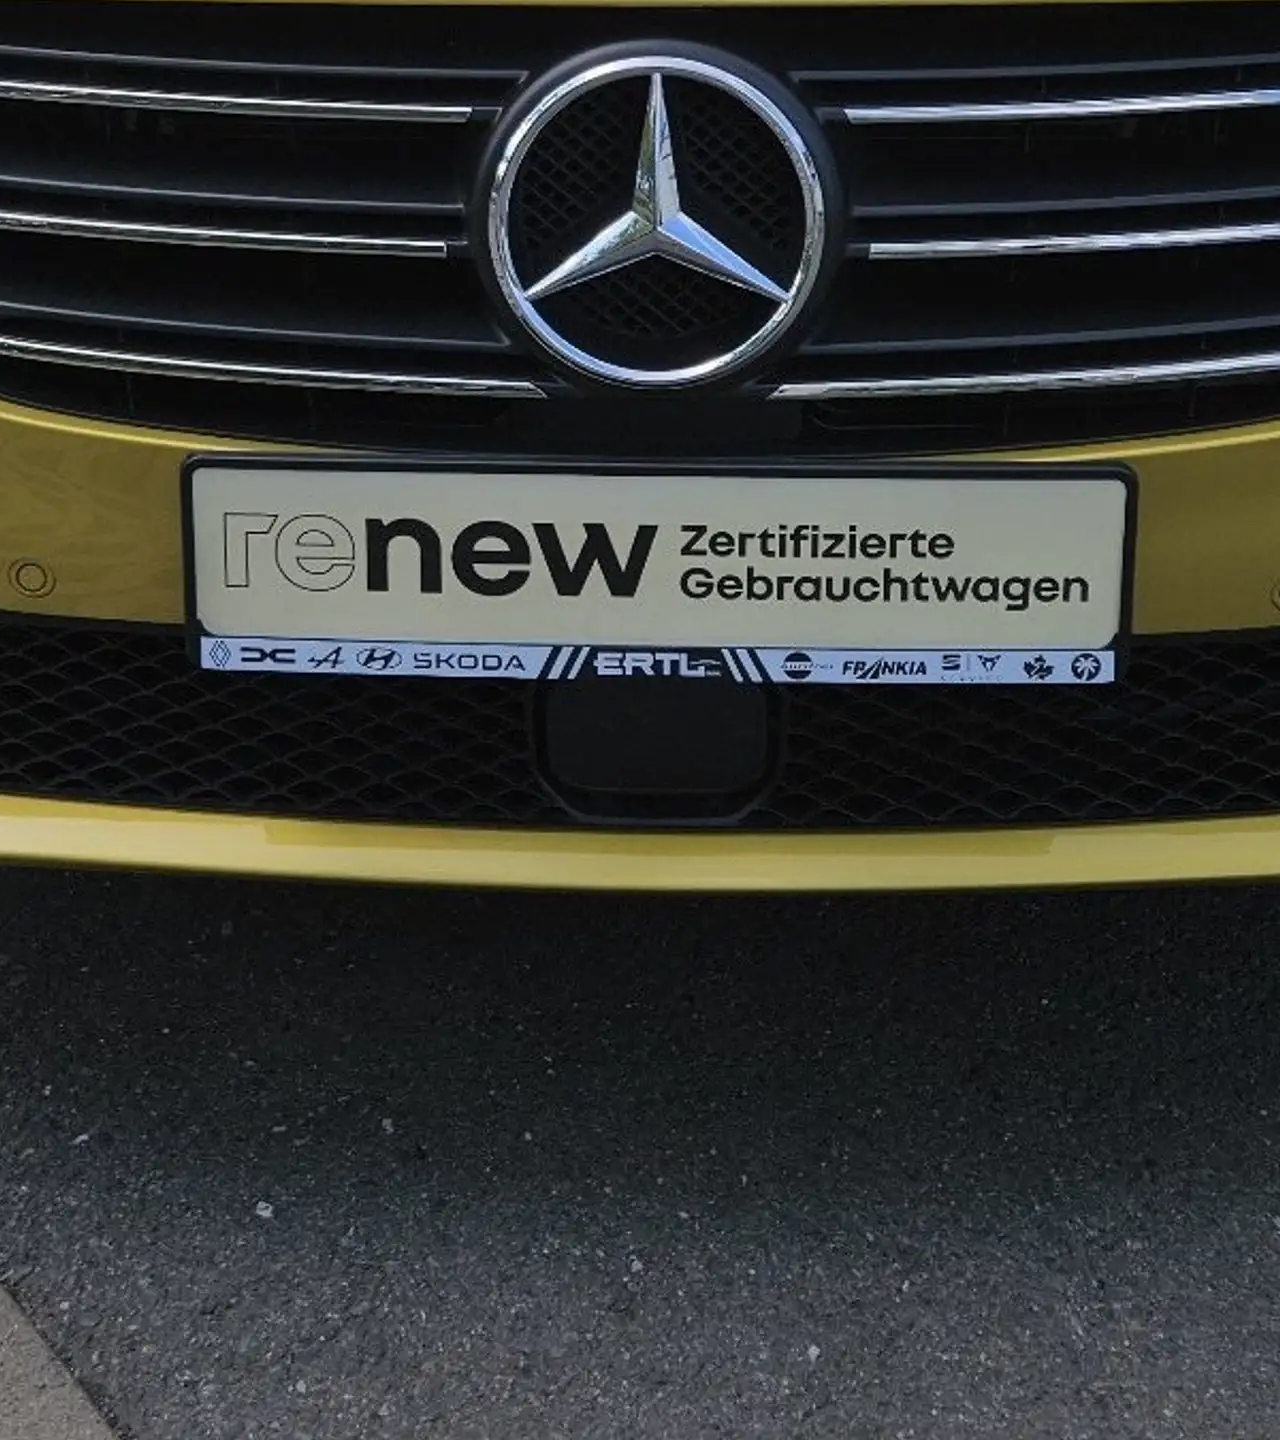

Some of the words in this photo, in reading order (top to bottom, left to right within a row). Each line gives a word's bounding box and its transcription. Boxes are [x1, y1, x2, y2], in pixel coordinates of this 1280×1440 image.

[223, 512, 658, 598] renew
[680, 524, 955, 559] Zertifizierte
[680, 566, 1089, 611] Gebrauchtwagen
[593, 651, 706, 677] ERTL
